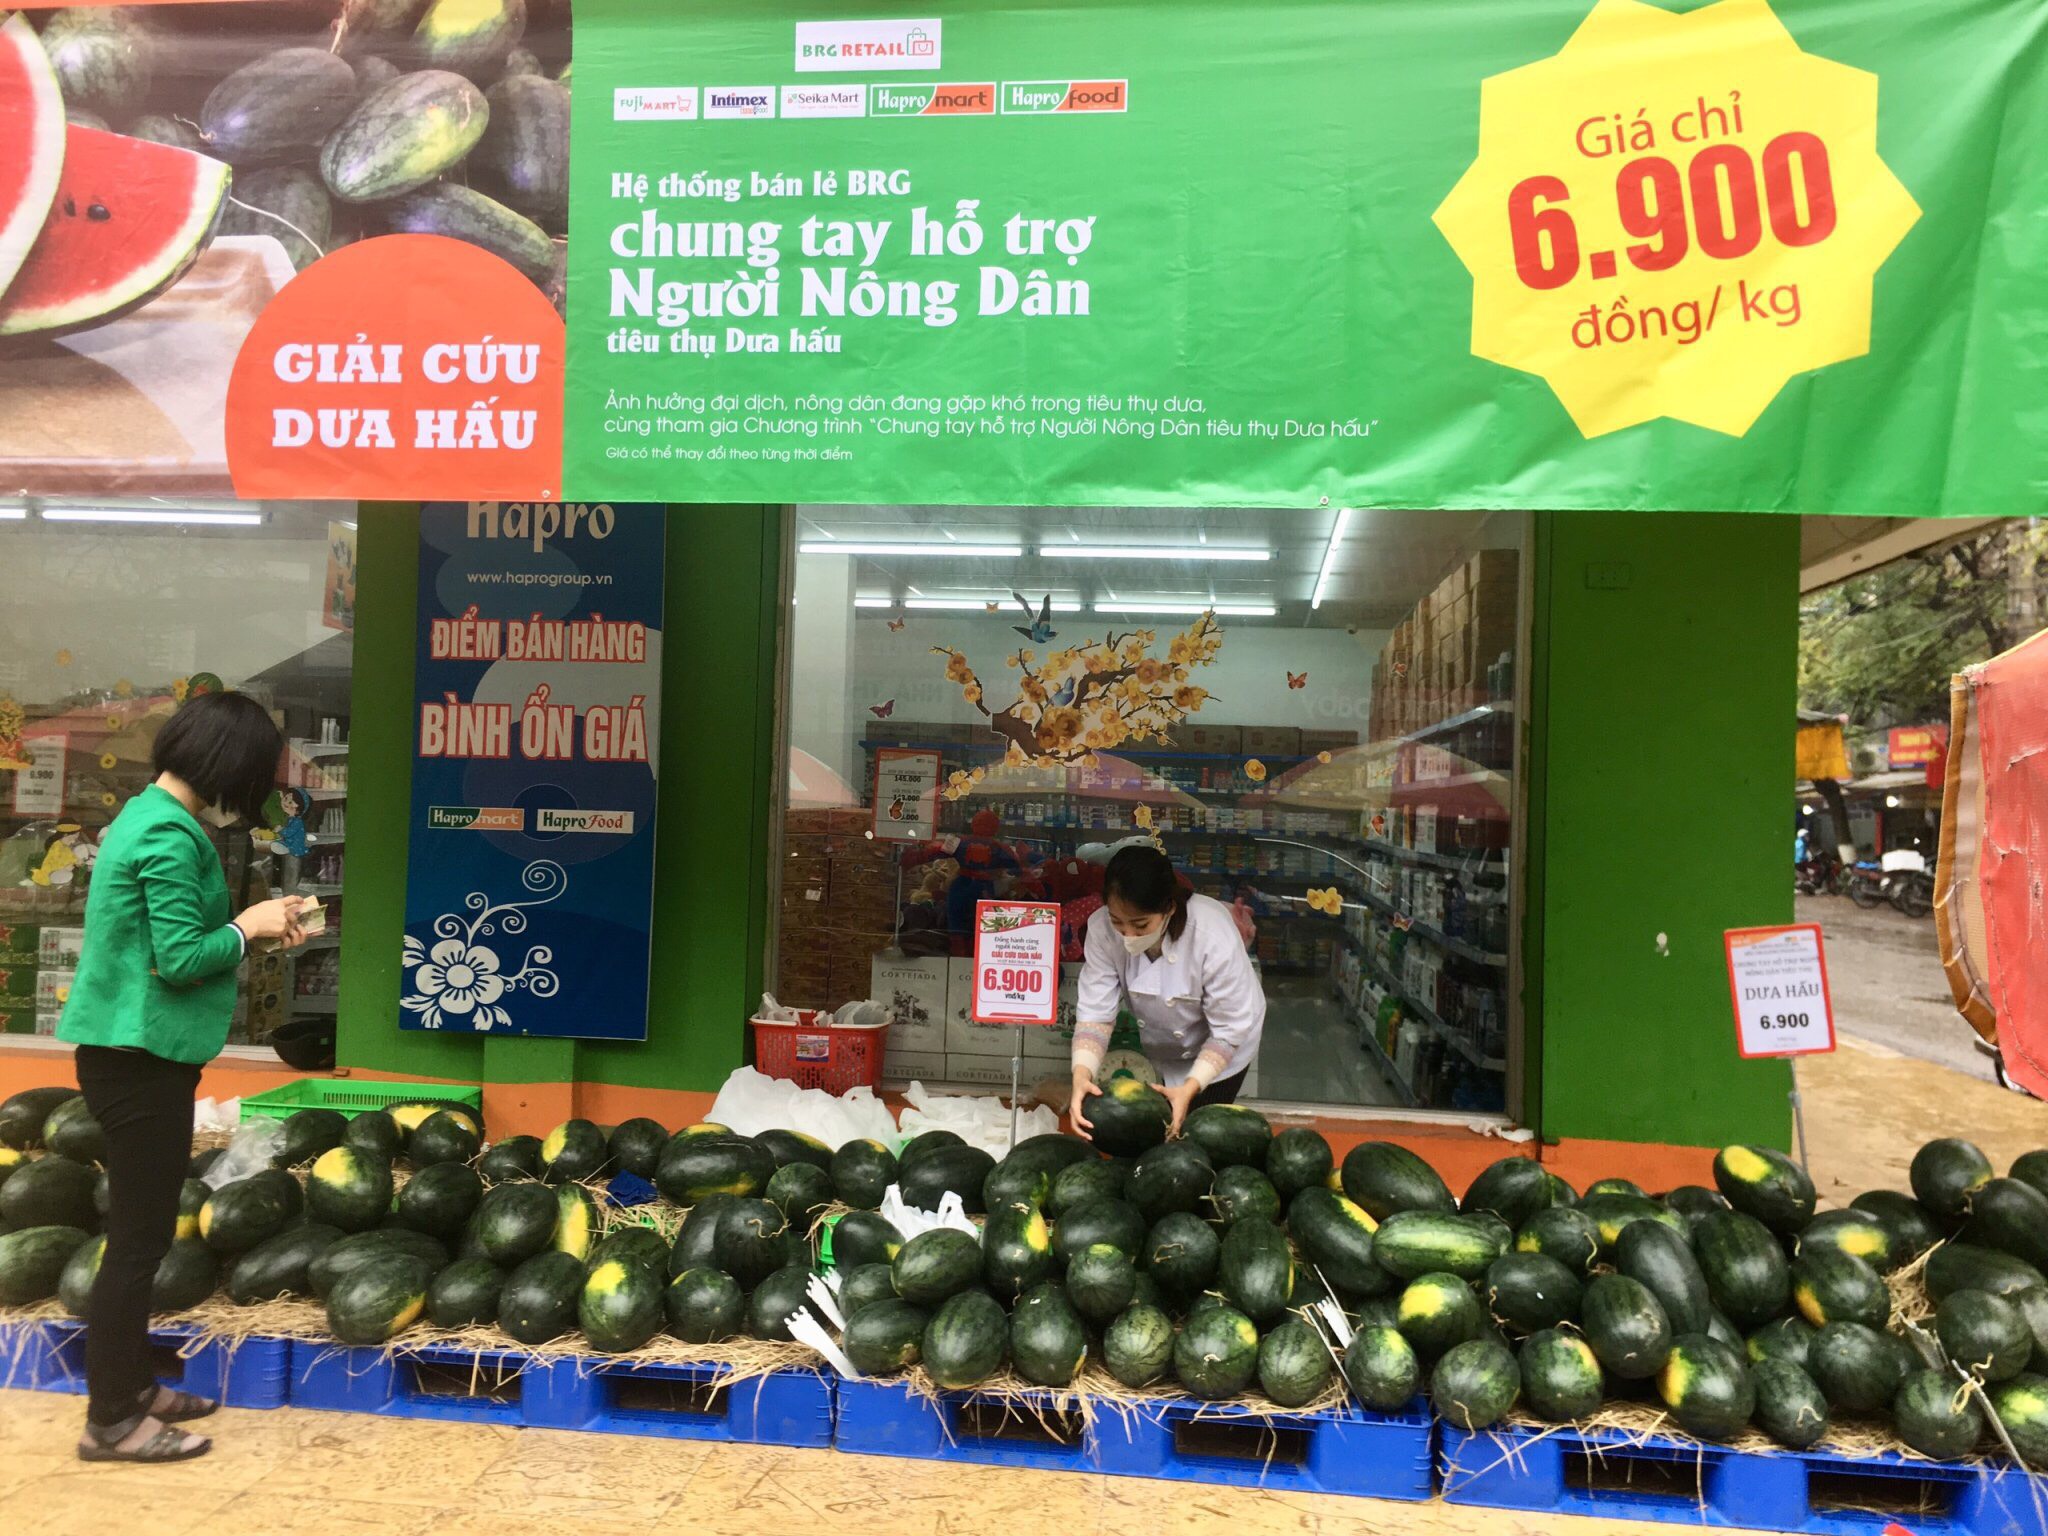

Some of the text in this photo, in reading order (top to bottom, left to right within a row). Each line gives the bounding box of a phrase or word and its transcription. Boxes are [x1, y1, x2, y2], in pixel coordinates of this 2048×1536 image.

[803, 43, 905, 57] BRG RETAIL
[711, 92, 768, 106] Intimex
[798, 92, 859, 105] Seika Mart
[878, 89, 987, 112] Hapro mart
[1012, 86, 1120, 110] Hapro food
[1576, 90, 1743, 158] Giá chỉ
[611, 169, 911, 203] Hệ thống bán lẻ BRG
[1508, 131, 1837, 291] 6.900
[610, 199, 1097, 267] chung tay hỗ trợ
[609, 266, 1090, 327] Người Nông Dân
[1739, 280, 1802, 327] kg
[606, 326, 841, 359] tiêu thụ Dưa hấu
[273, 333, 540, 384] GIẢI CỨU
[604, 389, 1207, 416] Ảnh hưởng đại dịch, nông dân đang gặp khó trong tiêu thụ dưa,
[272, 396, 537, 450] DƯA HẤU
[604, 417, 650, 437] cùng
[656, 416, 704, 433] tham
[710, 417, 738, 437] gia
[743, 417, 818, 437] Chương
[823, 417, 862, 434] trình
[945, 419, 975, 437] tay
[981, 415, 1005, 434] hỗ
[1011, 420, 1036, 438] trợ
[1041, 418, 1097, 438] Người
[1102, 418, 1154, 439] Nông
[1160, 418, 1200, 436] Dân
[1206, 420, 1242, 437] tiêu
[1247, 420, 1278, 439] thụ
[1284, 420, 1325, 437] Dưa
[606, 445, 853, 462] Giá có thể thay đổi theo từng thời điểm
[467, 501, 615, 552] Hapro
[467, 572, 613, 587] www.haprogroup.vn
[430, 604, 647, 663] ĐIỂM BÁN HÀNG
[419, 683, 649, 762] BÌNH ỔN GIÁ
[433, 809, 519, 827] Hapro mart
[881, 971, 937, 981] CORTEJADA
[983, 967, 1042, 993] 6.900
[1744, 981, 1820, 1001] DƯA HẤU
[1760, 1013, 1809, 1030] 6.900
